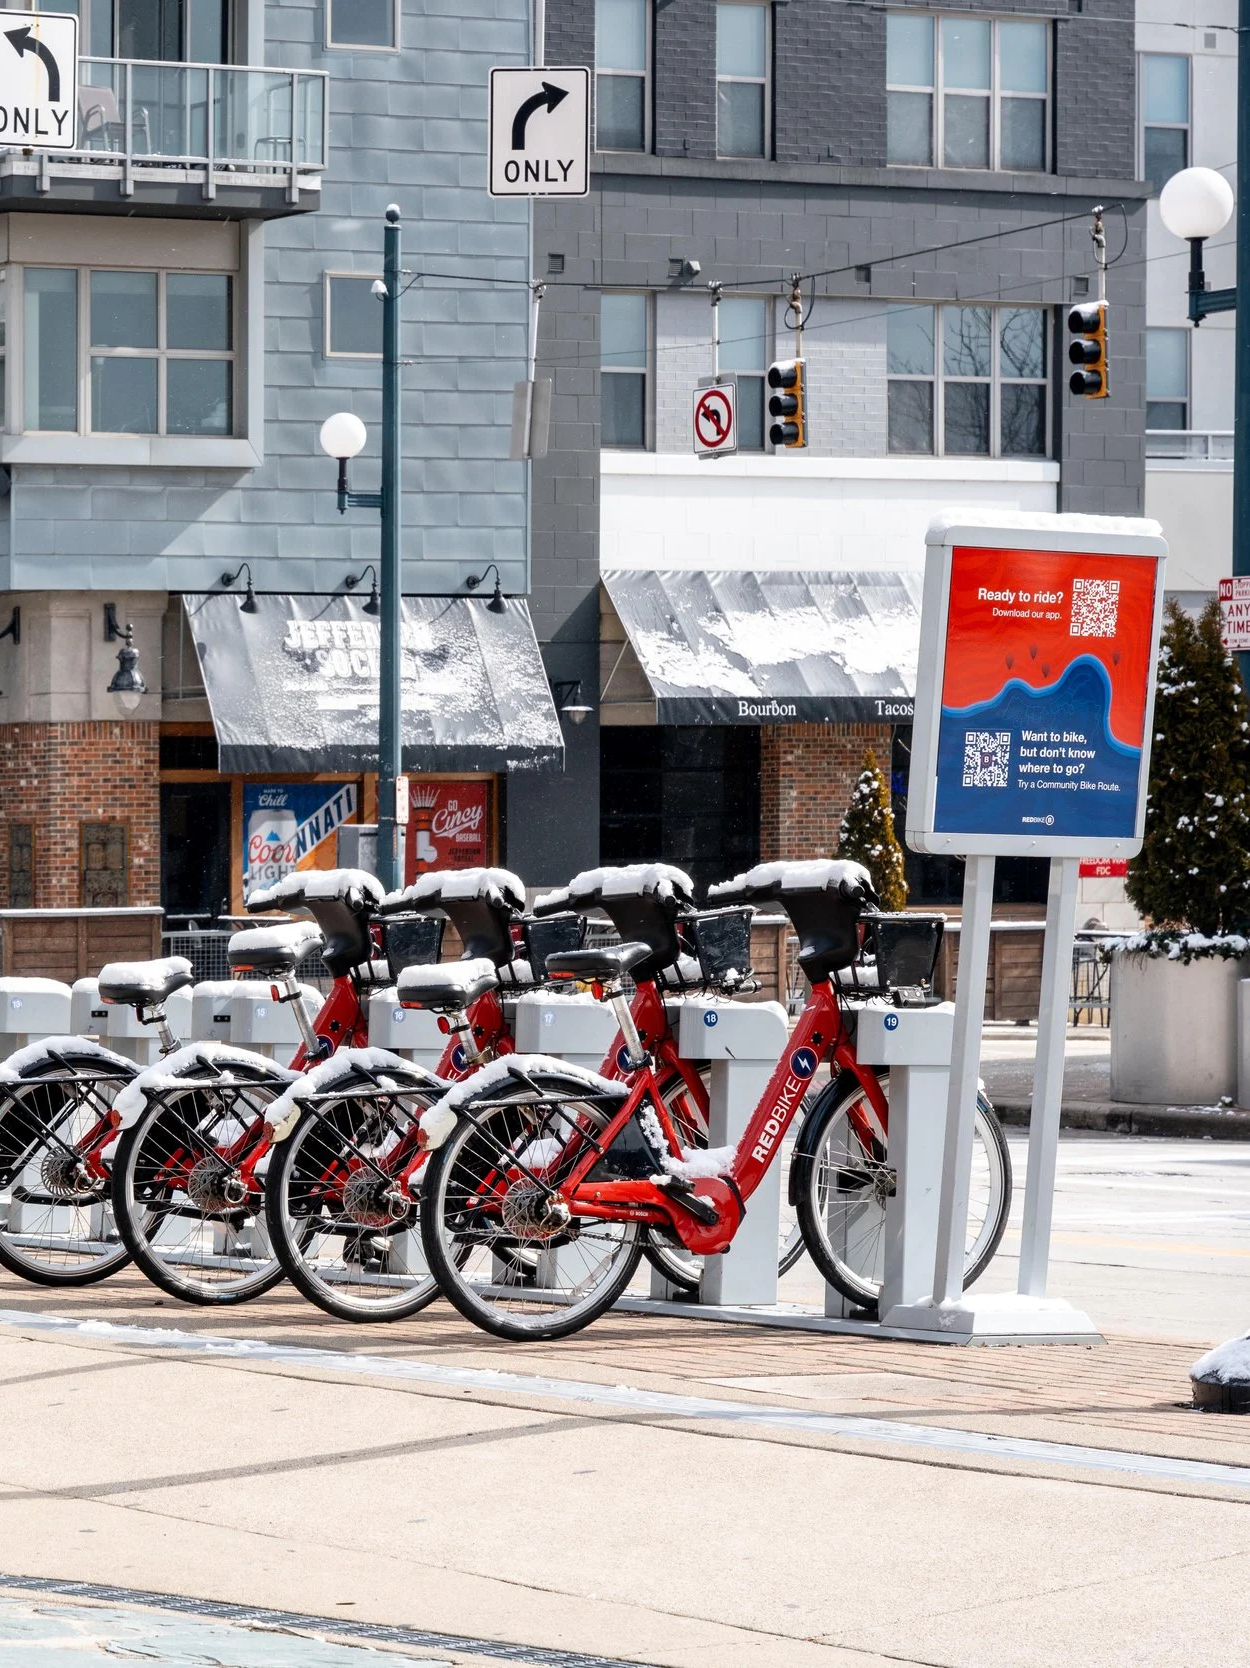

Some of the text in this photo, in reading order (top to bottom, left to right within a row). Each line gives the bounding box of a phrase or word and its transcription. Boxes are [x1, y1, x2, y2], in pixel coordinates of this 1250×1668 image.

[504, 159, 575, 183] ONLY
[977, 588, 1063, 604] Ready to ride?
[1219, 583, 1232, 597] NO
[992, 608, 1062, 620] Download our app.
[738, 700, 914, 716] Bourbon Tacos
[1021, 730, 1087, 744] Want to bike,
[1020, 746, 1096, 759] but don't know
[1019, 762, 1085, 776] where to go?
[1017, 780, 1028, 789] Try
[1036, 780, 1079, 791] Community
[1080, 781, 1096, 790] Bike
[1097, 781, 1121, 792] Route.
[258, 793, 288, 807] Chill
[447, 799, 459, 812] GO
[297, 787, 353, 859] NNATI
[431, 804, 484, 834] Cincy
[455, 833, 482, 842] BASEBALL
[1096, 866, 1111, 875] FDC
[544, 1014, 554, 1023] 17
[706, 1014, 717, 1023] 18
[886, 1018, 897, 1027] 19
[751, 1075, 802, 1164] REDBIKE
